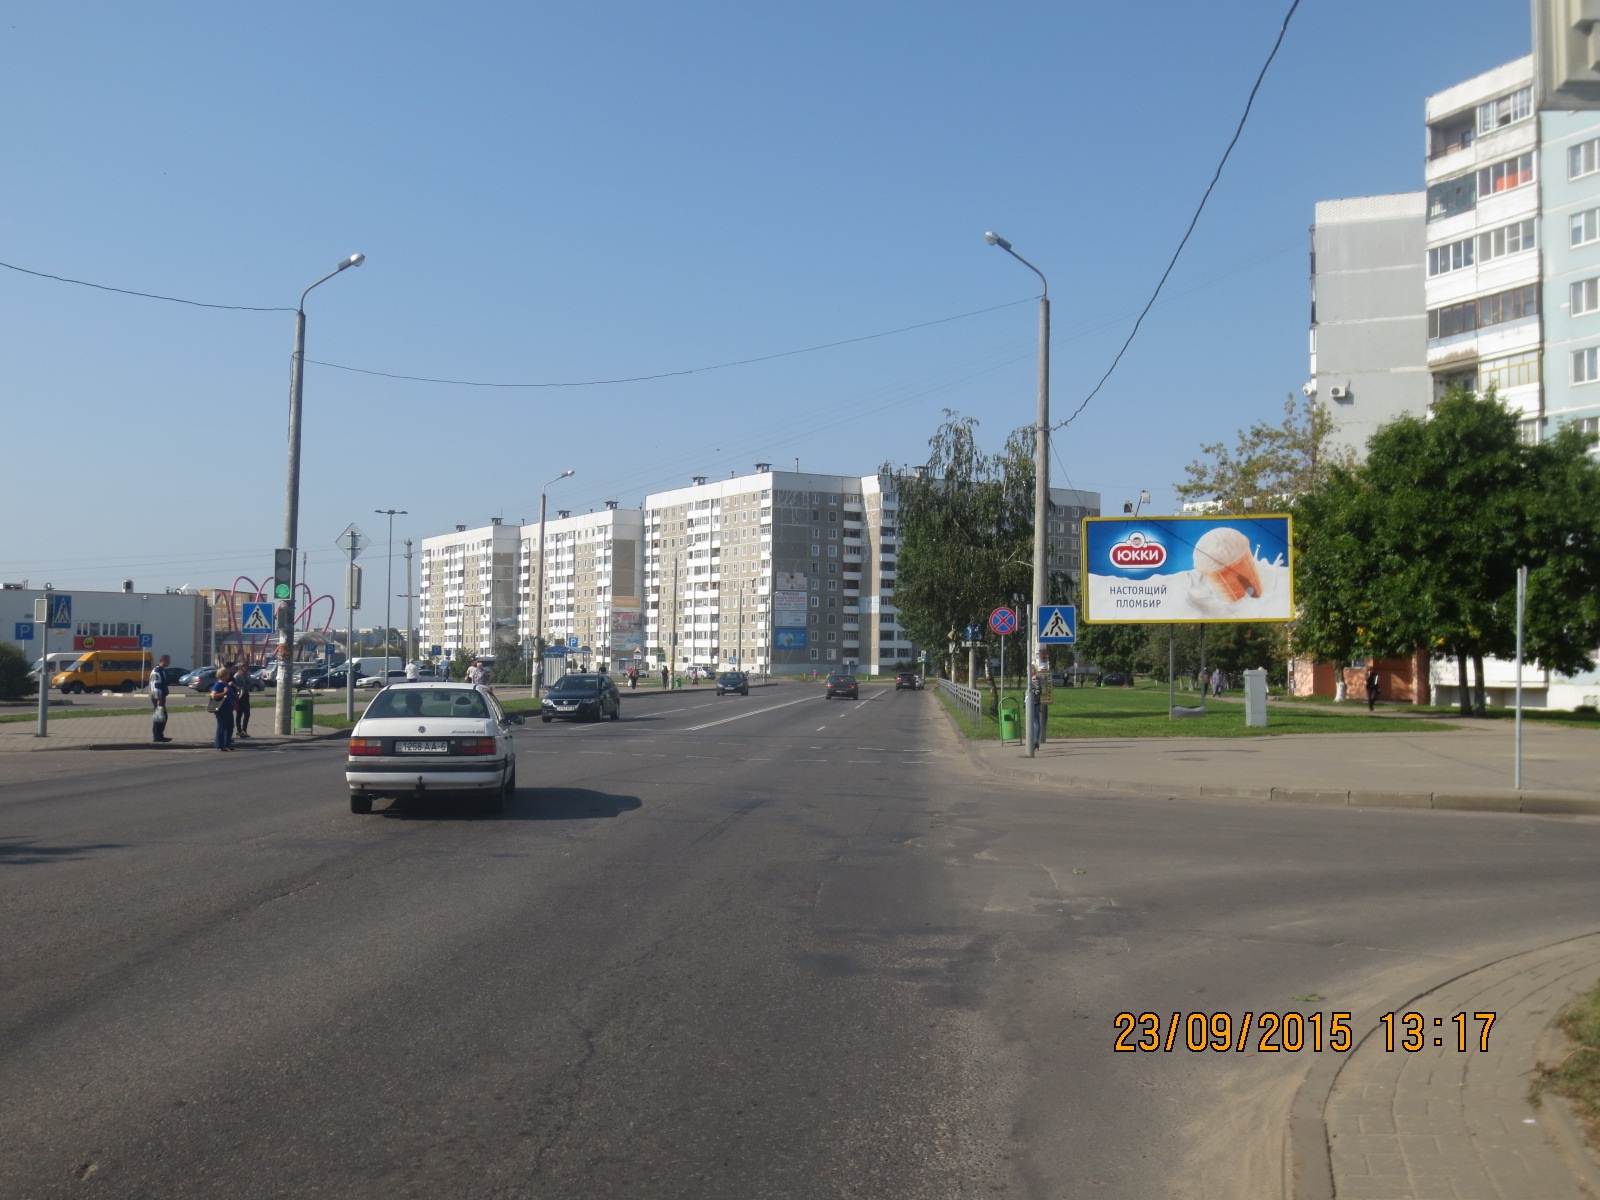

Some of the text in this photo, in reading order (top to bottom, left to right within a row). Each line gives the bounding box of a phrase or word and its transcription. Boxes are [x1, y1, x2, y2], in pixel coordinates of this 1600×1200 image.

[1117, 550, 1159, 561] ЮККИ
[1109, 584, 1167, 595] НАСТОЯЩИЙ
[1116, 599, 1161, 608] ПЛОМБИР
[20, 624, 30, 638] P
[142, 635, 150, 646] P
[403, 742, 422, 751] 1258
